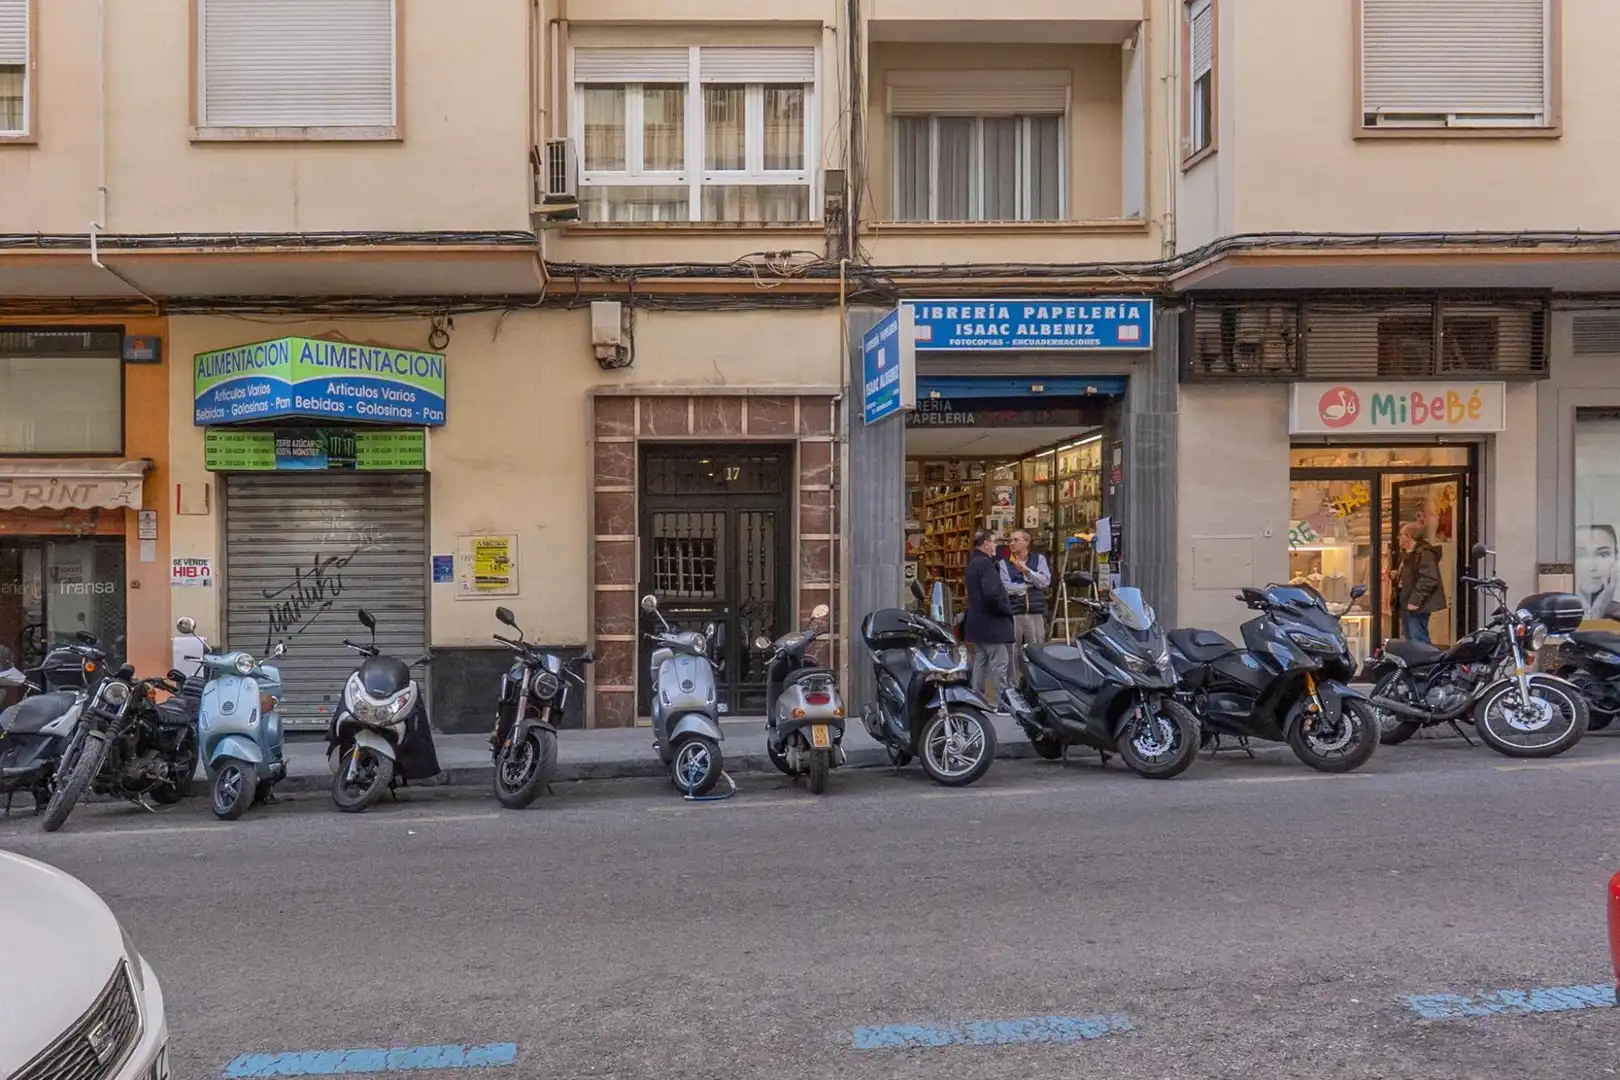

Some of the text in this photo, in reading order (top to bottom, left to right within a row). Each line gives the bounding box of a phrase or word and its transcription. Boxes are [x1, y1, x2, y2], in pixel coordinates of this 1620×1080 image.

[1024, 303, 1141, 319] PAPELERÍA
[956, 323, 1095, 336] ISAAC ALBENIZ
[949, 338, 1003, 346] FOTOCOPIAS
[1012, 338, 1101, 346] ENCUADERNACIONES
[197, 341, 288, 379] ALIMENTACION
[300, 342, 443, 379] ALIMENTACION
[247, 381, 271, 396] Varios
[327, 382, 416, 403] Articulos Varios
[196, 407, 225, 421] Bebidas
[231, 400, 269, 417] Golosinas
[275, 396, 291, 410] Pan
[295, 395, 345, 413] Bebidas
[356, 401, 413, 419] Golosinas
[423, 407, 444, 421] Pan
[1371, 386, 1483, 425] MiBeBé
[906, 412, 976, 425] PAPELERIA
[724, 467, 741, 481] 17
[173, 558, 208, 566] SE VENDE
[173, 566, 210, 577] HIELO
[59, 579, 115, 595] fransa
